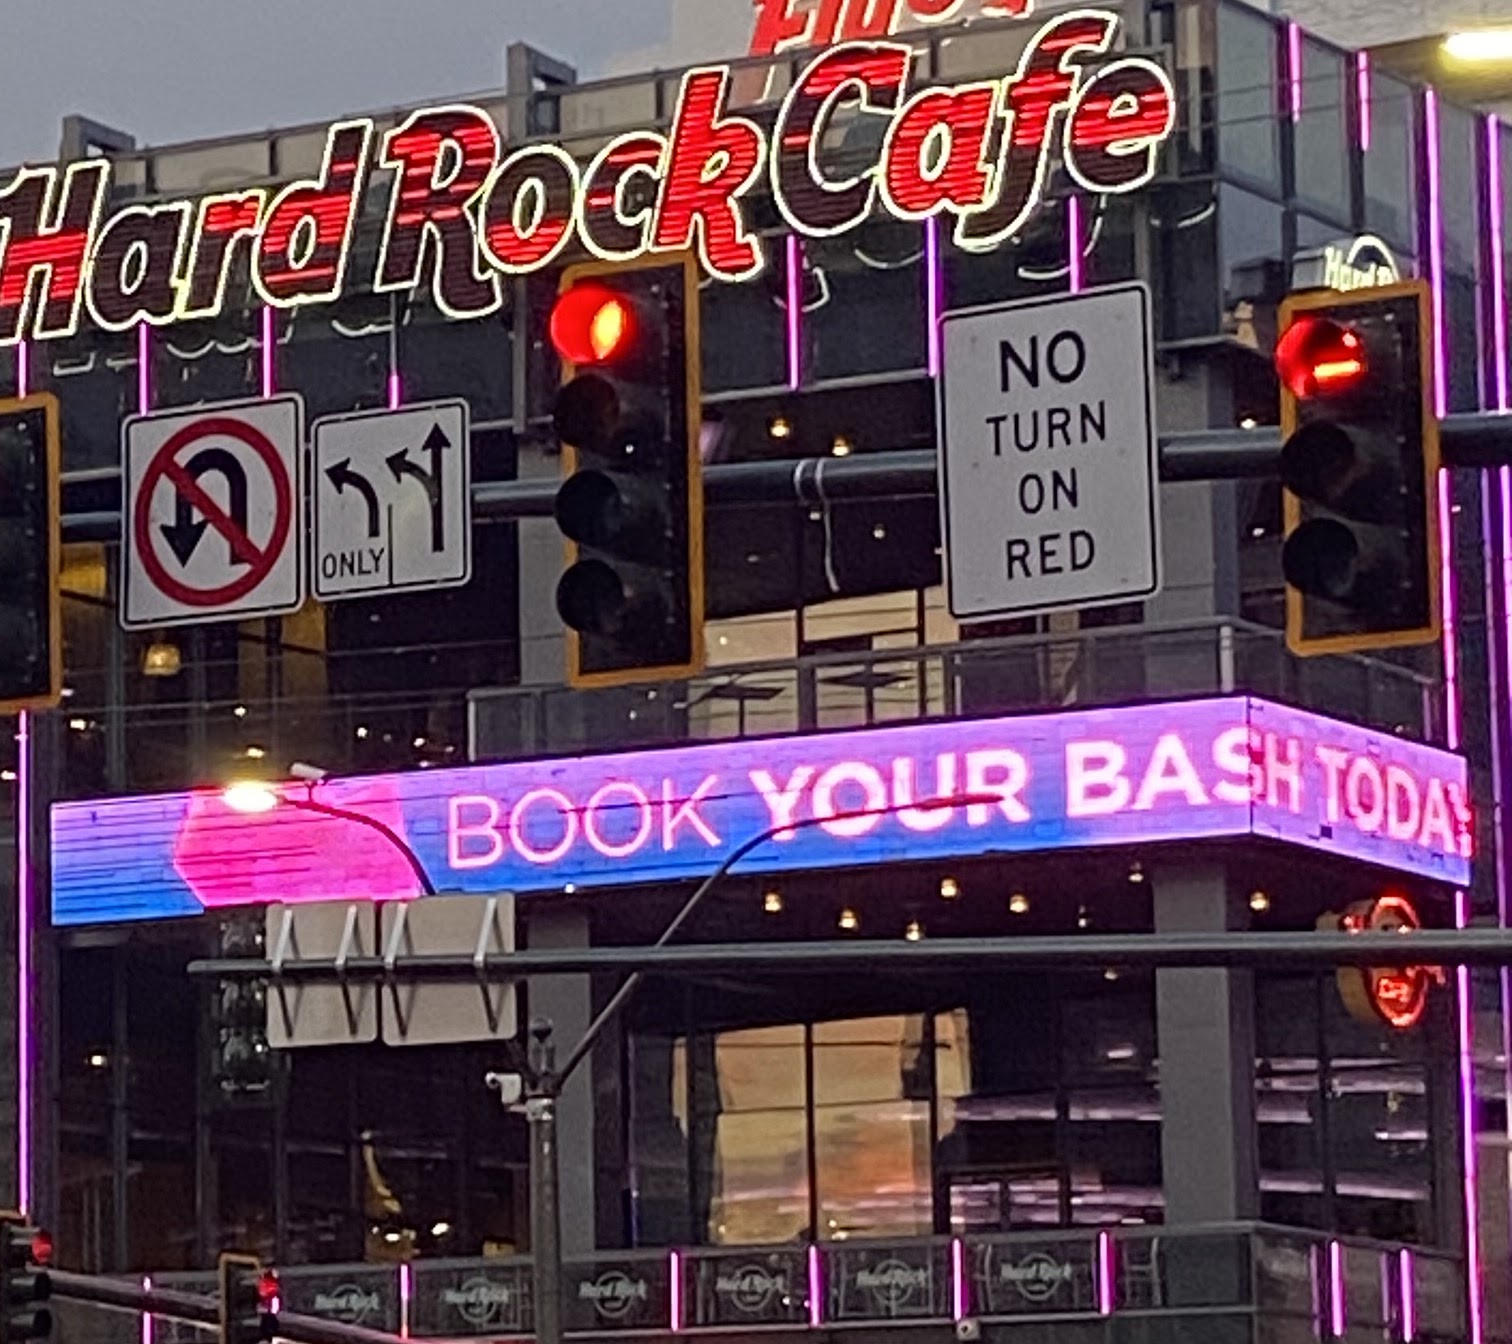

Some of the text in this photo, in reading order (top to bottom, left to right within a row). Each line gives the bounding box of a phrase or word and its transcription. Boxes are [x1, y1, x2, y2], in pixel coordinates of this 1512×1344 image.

[375, 64, 767, 320] Rock
[770, 8, 1176, 249] Cafe
[999, 329, 1086, 393] NO
[986, 400, 1107, 458] TURN
[1019, 467, 1079, 515] ON
[321, 546, 386, 580] ONLY
[1006, 530, 1096, 581] RED
[447, 773, 722, 869] BOOK
[749, 746, 1031, 842] YOUR
[1064, 724, 1301, 819] BASH
